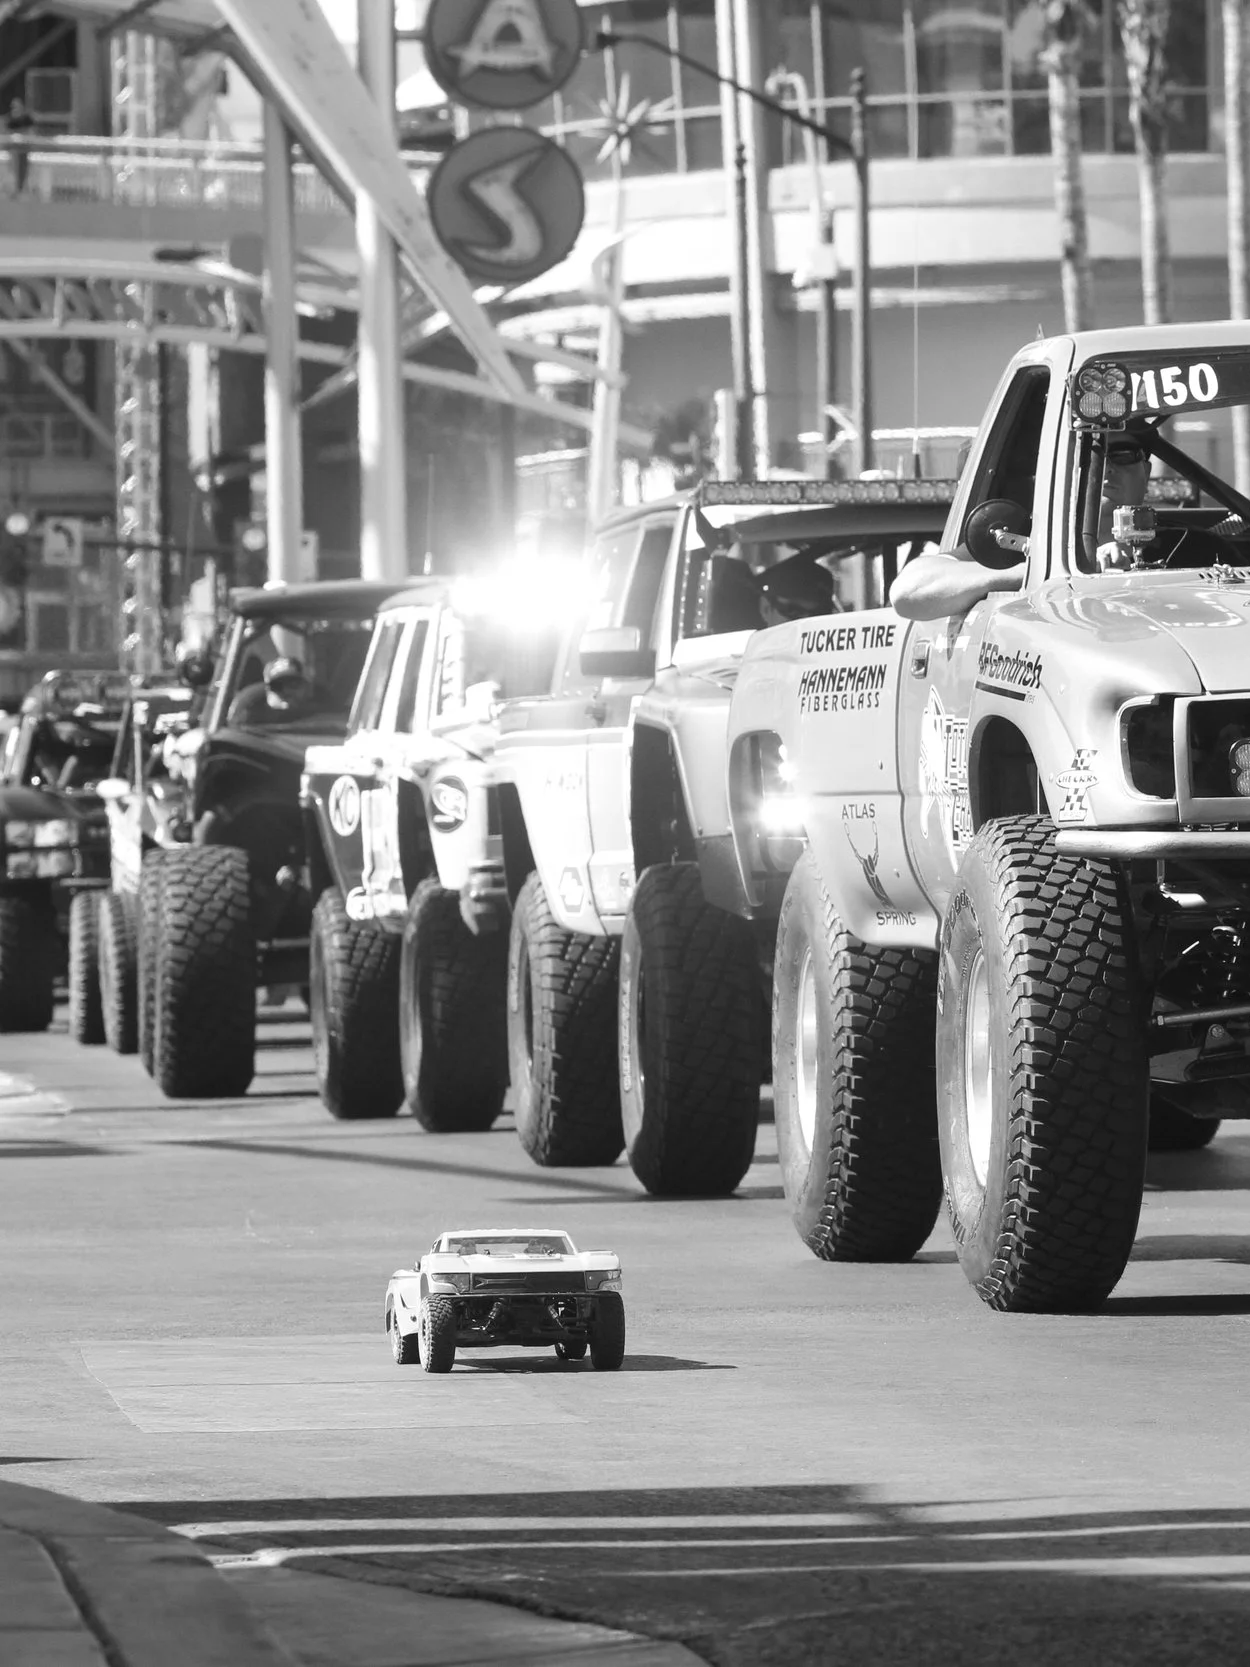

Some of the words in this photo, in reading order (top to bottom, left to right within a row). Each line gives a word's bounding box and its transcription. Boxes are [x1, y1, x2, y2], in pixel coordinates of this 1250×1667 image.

[800, 628, 857, 655] TUCKER
[861, 625, 896, 649] TIRE
[978, 641, 1042, 690] BFGoodrich
[798, 663, 887, 698] HANNEMANN
[800, 691, 880, 714] FIBERGLASS
[841, 802, 876, 820] ATLAS
[876, 911, 917, 926] SPRING
